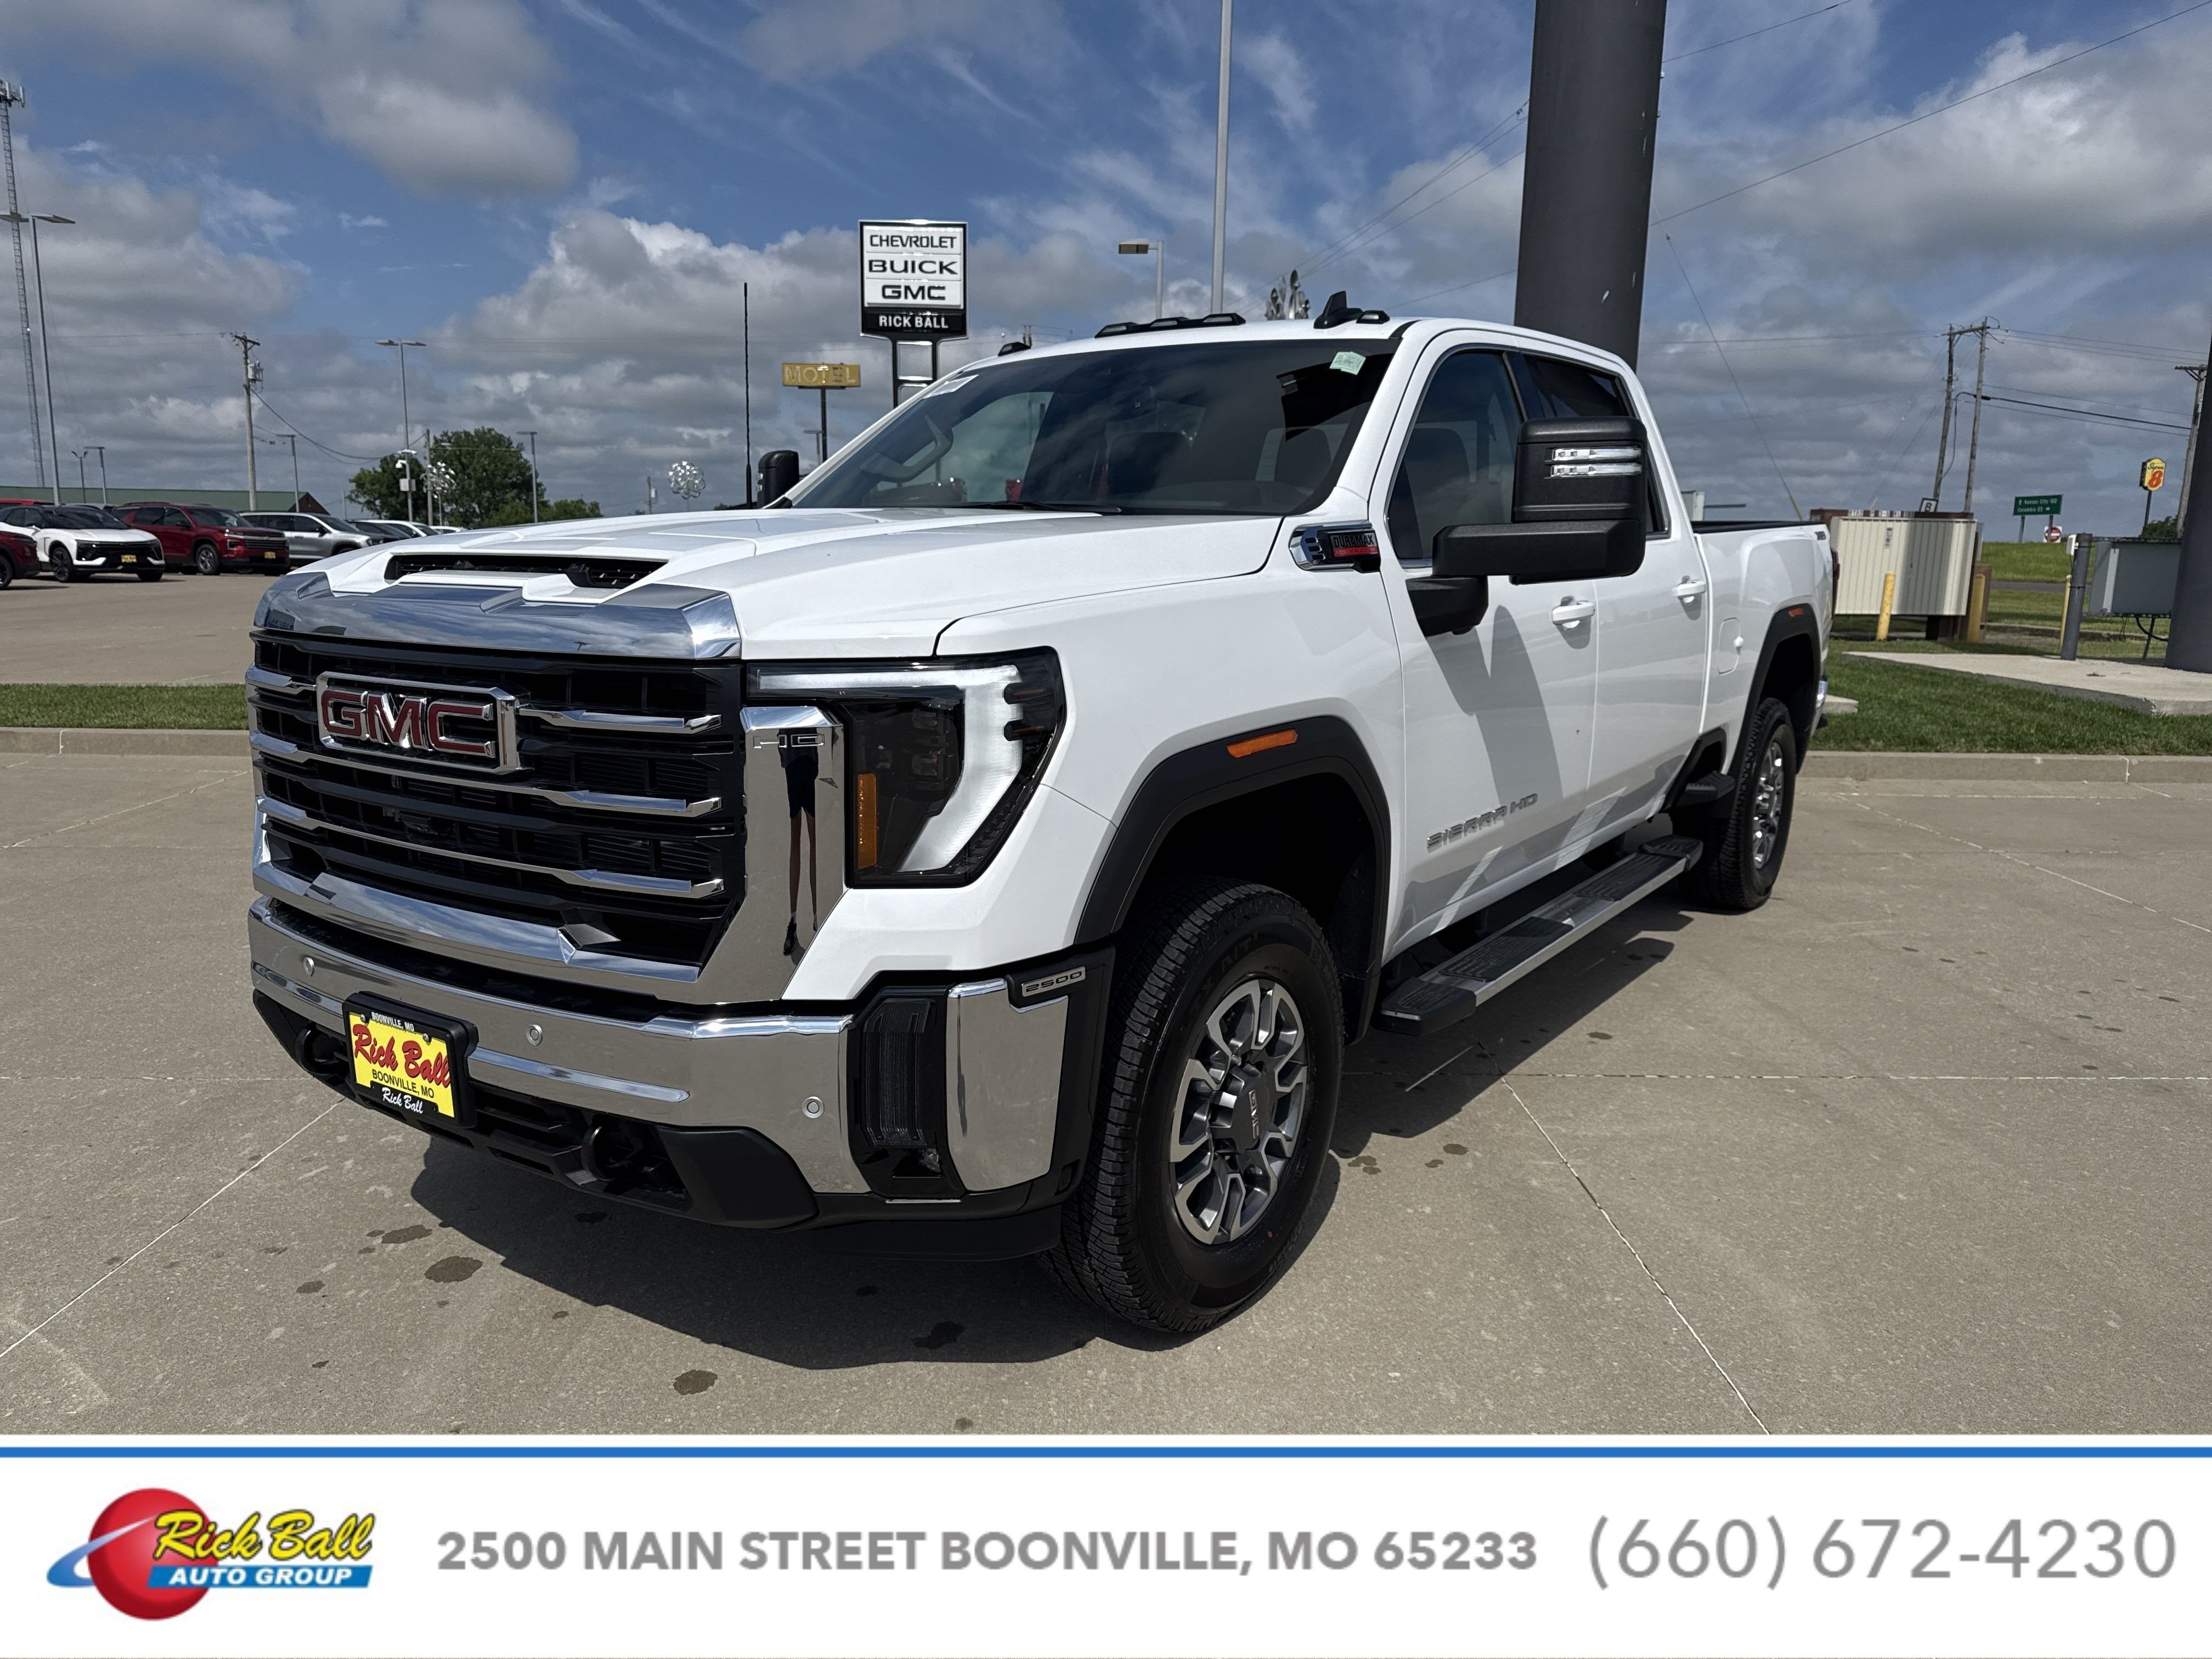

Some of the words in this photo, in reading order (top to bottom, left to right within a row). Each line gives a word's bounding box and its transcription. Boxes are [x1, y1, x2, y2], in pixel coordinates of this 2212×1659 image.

[870, 235, 957, 249] CHEVROLET
[868, 259, 958, 274] BUICK
[882, 285, 946, 300] GMC
[879, 316, 911, 328] RICK
[915, 317, 949, 329] BALL
[785, 366, 856, 383] MOTEL
[2148, 470, 2163, 488] 8
[1333, 534, 1374, 548] DURAMAX
[320, 689, 495, 758] GMC
[753, 733, 825, 748] HD
[1427, 806, 1508, 848] SIERRA
[1510, 793, 1538, 814] HD
[1026, 971, 1082, 992] 2500
[371, 1012, 404, 1030] BOONVILLE,
[405, 1022, 415, 1031] MO
[353, 1024, 398, 1071] Rick
[402, 1040, 451, 1087] Ball
[372, 1069, 420, 1095] BOONVILLE,
[421, 1088, 435, 1098] MO
[382, 1087, 402, 1107] Rick
[403, 1095, 424, 1114] Ball
[1249, 1090, 1260, 1139] GMC
